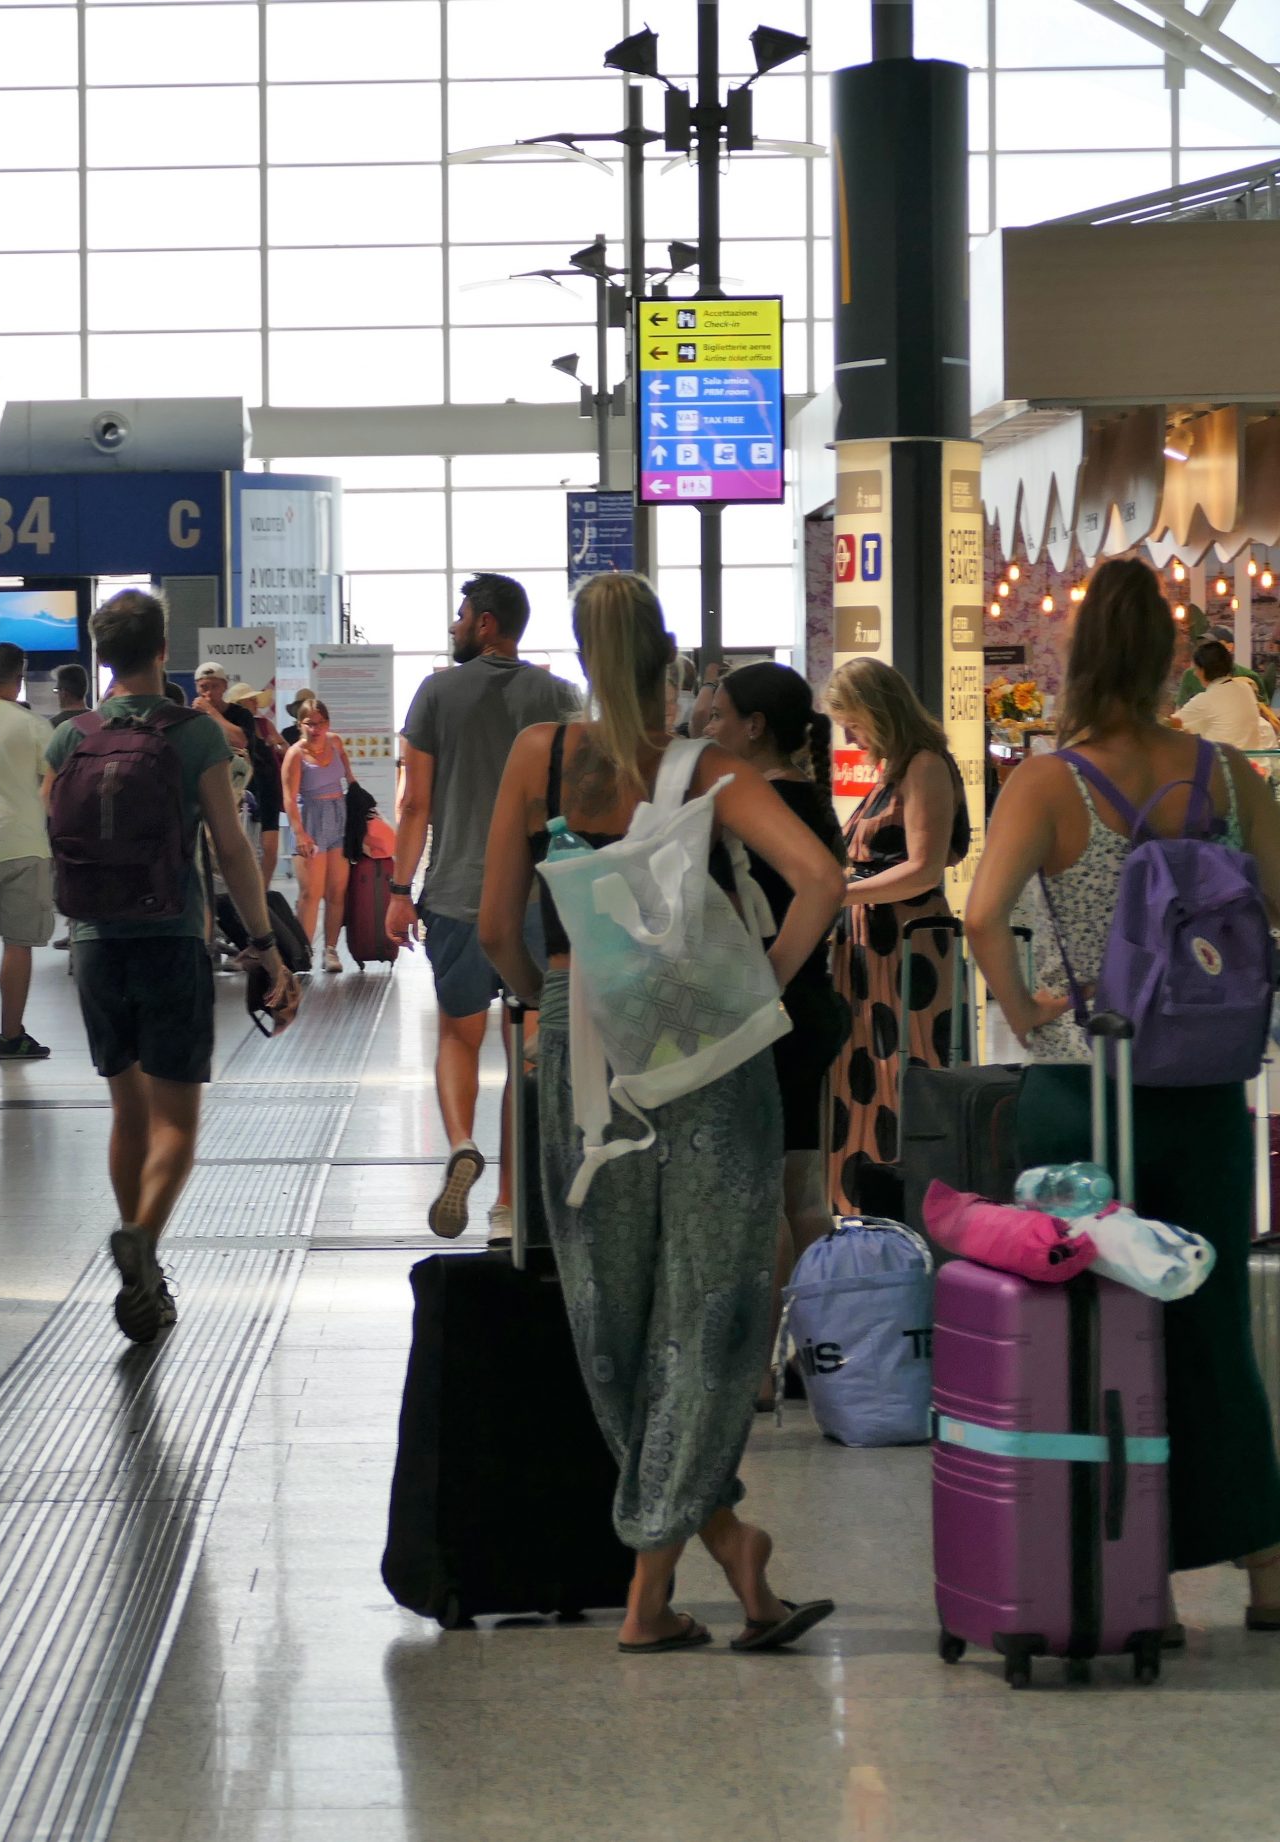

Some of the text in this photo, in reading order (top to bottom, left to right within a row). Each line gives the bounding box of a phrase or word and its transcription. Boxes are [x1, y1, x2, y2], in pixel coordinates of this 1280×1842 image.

[703, 320, 741, 328] Check-in
[703, 344, 747, 353] Biglietterie
[703, 416, 745, 424] TAX FREE
[683, 450, 693, 461] P
[168, 500, 202, 550] C
[249, 517, 286, 531] VOLOTEA
[250, 568, 258, 588] A
[260, 568, 286, 588] VOLTE
[207, 644, 255, 655] VOLOTEA
